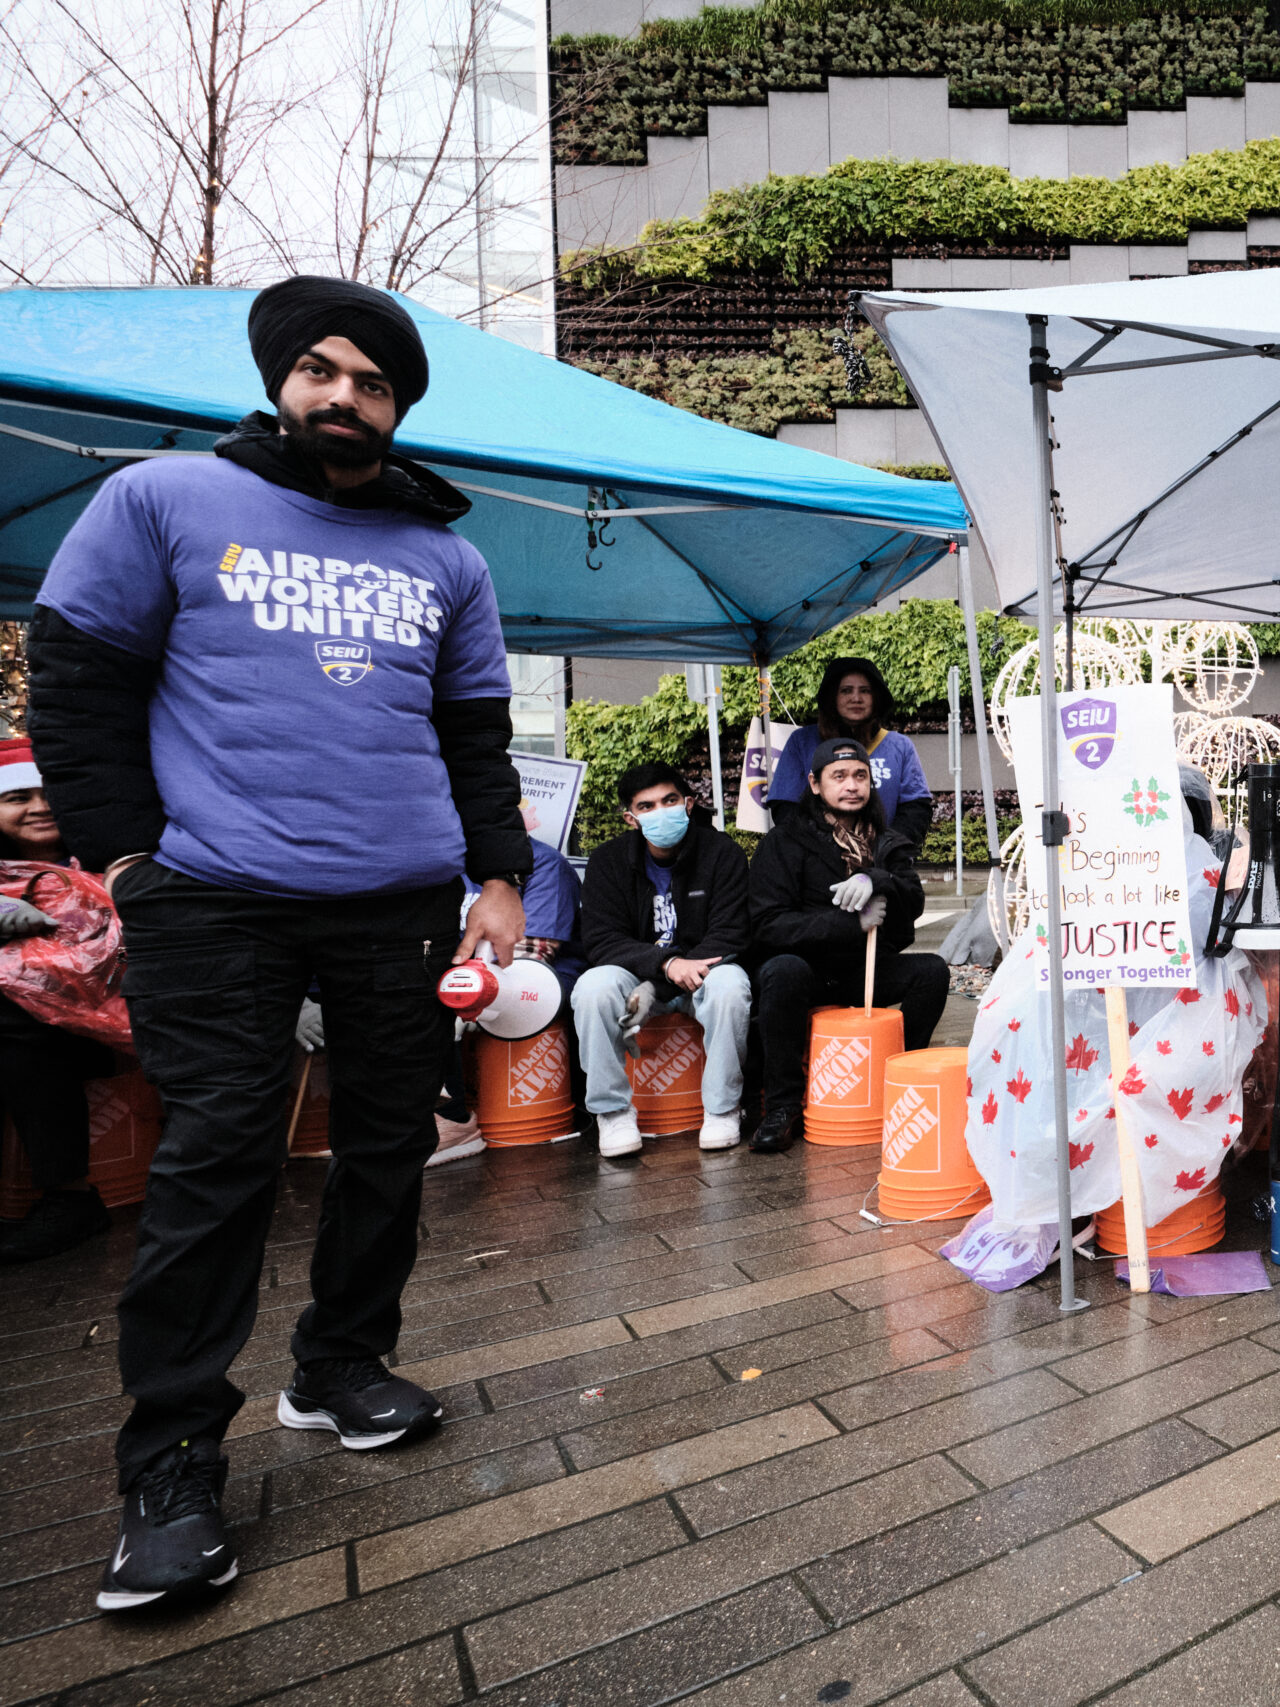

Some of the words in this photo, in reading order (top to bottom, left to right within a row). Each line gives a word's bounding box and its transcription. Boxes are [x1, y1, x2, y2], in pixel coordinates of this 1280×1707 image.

[219, 543, 242, 573] SEIU
[234, 547, 435, 603] AIRPORT
[217, 574, 443, 632] WORKERS
[254, 602, 421, 647] UNITED
[321, 645, 364, 659] SEIU
[338, 667, 352, 681] 2
[1067, 707, 1111, 729] SEIU
[1086, 741, 1101, 763] 2
[520, 776, 566, 790] REMENT
[522, 788, 556, 800] URITY
[1070, 840, 1160, 880] Beginning
[1248, 860, 1258, 888] PYLE
[1062, 884, 1096, 911] look
[1104, 892, 1114, 905] a
[1123, 884, 1142, 905] lot
[1155, 884, 1181, 906] like
[1060, 920, 1177, 960] JUSTICE
[1040, 968, 1113, 983] Songer
[1117, 965, 1192, 983] Together
[520, 991, 538, 1002] PYLE
[510, 1034, 568, 1105] HOME
[511, 1033, 555, 1080] DEPOT
[634, 1028, 692, 1087] DEPOT
[647, 1042, 703, 1096] HOME
[810, 1038, 870, 1105] HOME
[832, 1071, 863, 1100] THE
[885, 1105, 938, 1169] HOME
